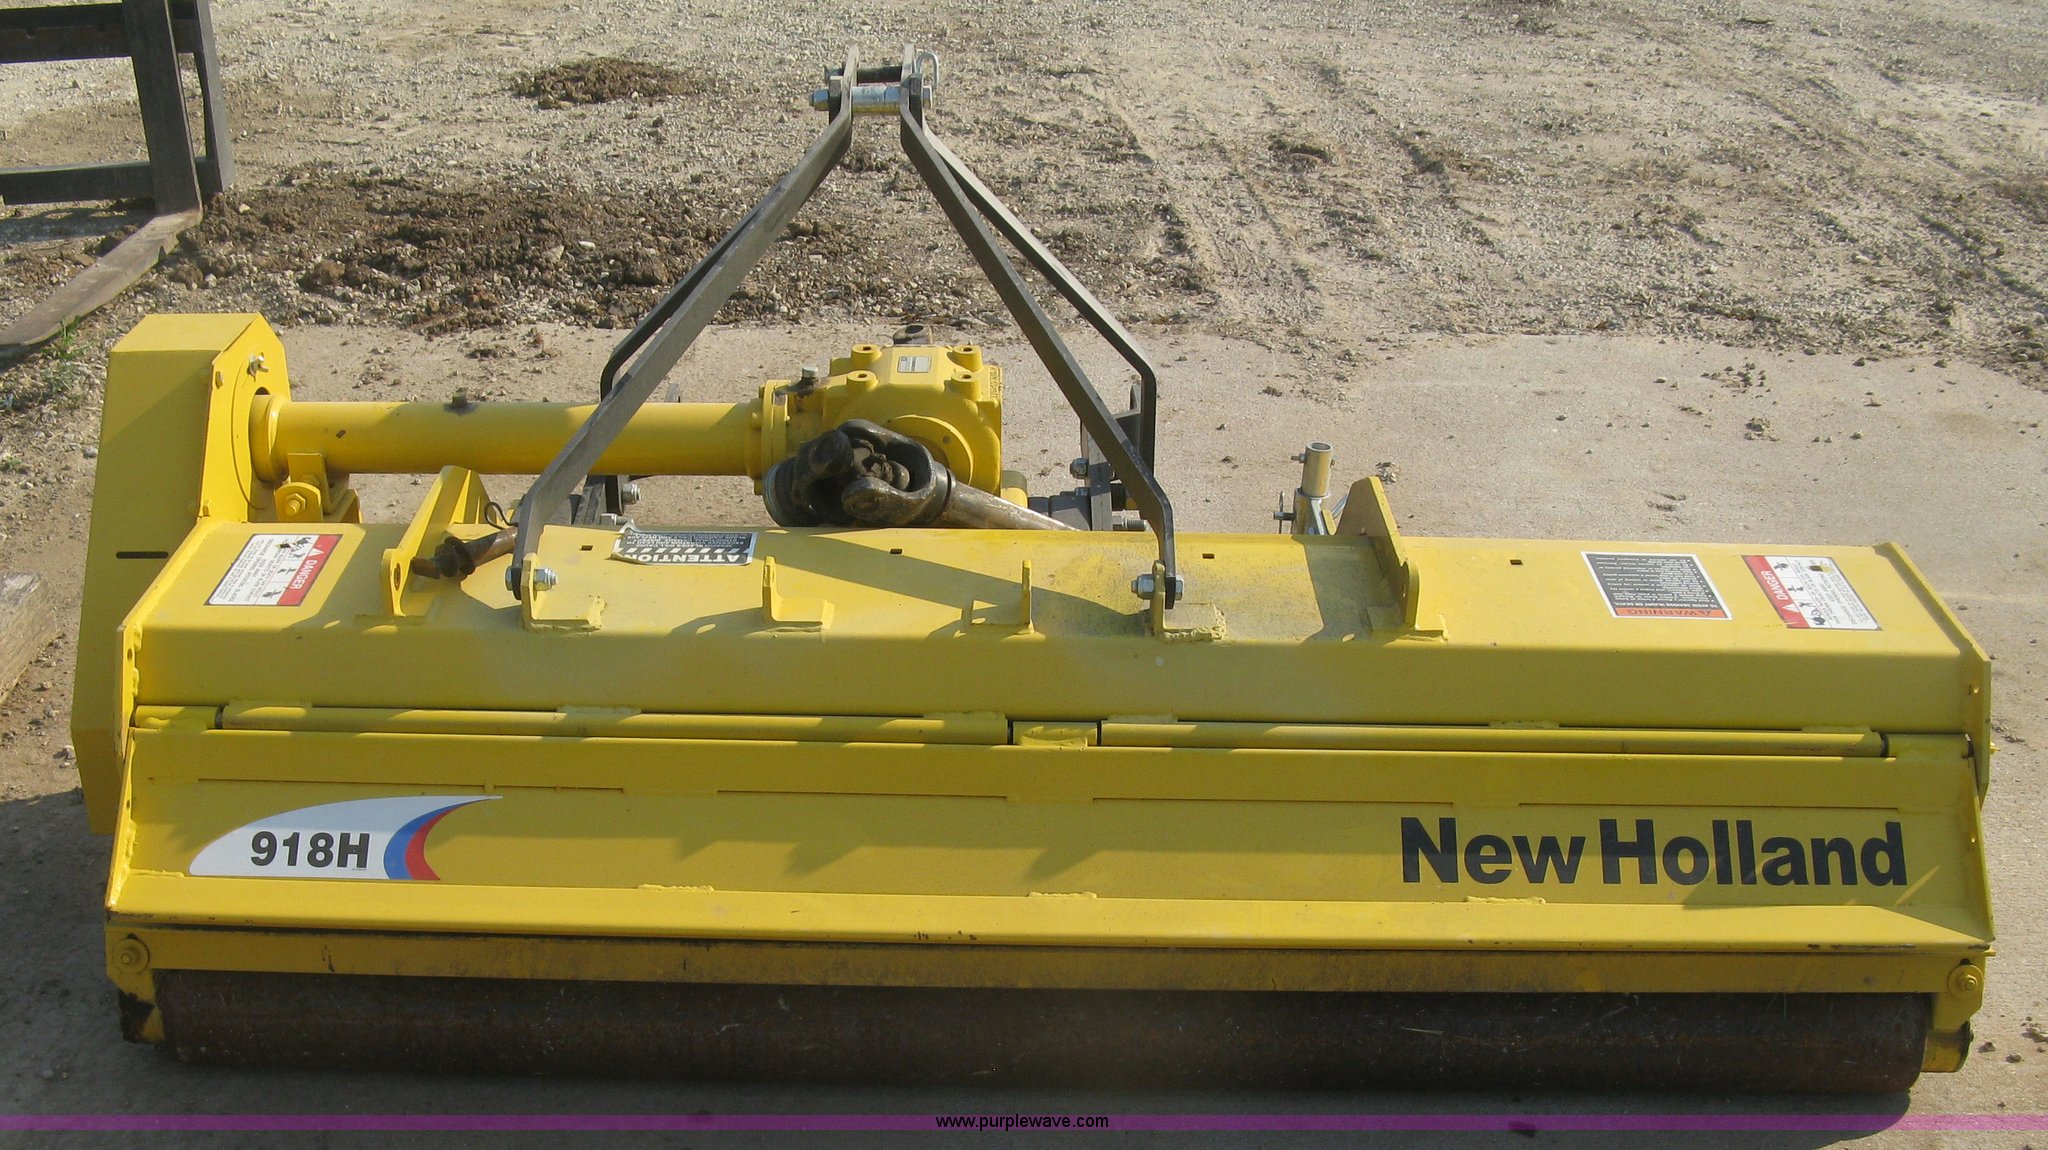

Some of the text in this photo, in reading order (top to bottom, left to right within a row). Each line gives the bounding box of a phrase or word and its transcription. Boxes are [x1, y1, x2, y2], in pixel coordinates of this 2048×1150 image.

[624, 554, 741, 563] ATTENTION
[289, 560, 318, 589] DANGER
[1760, 570, 1789, 600] DANGER
[250, 830, 371, 869] 918H
[1401, 817, 1908, 886] New Holland
